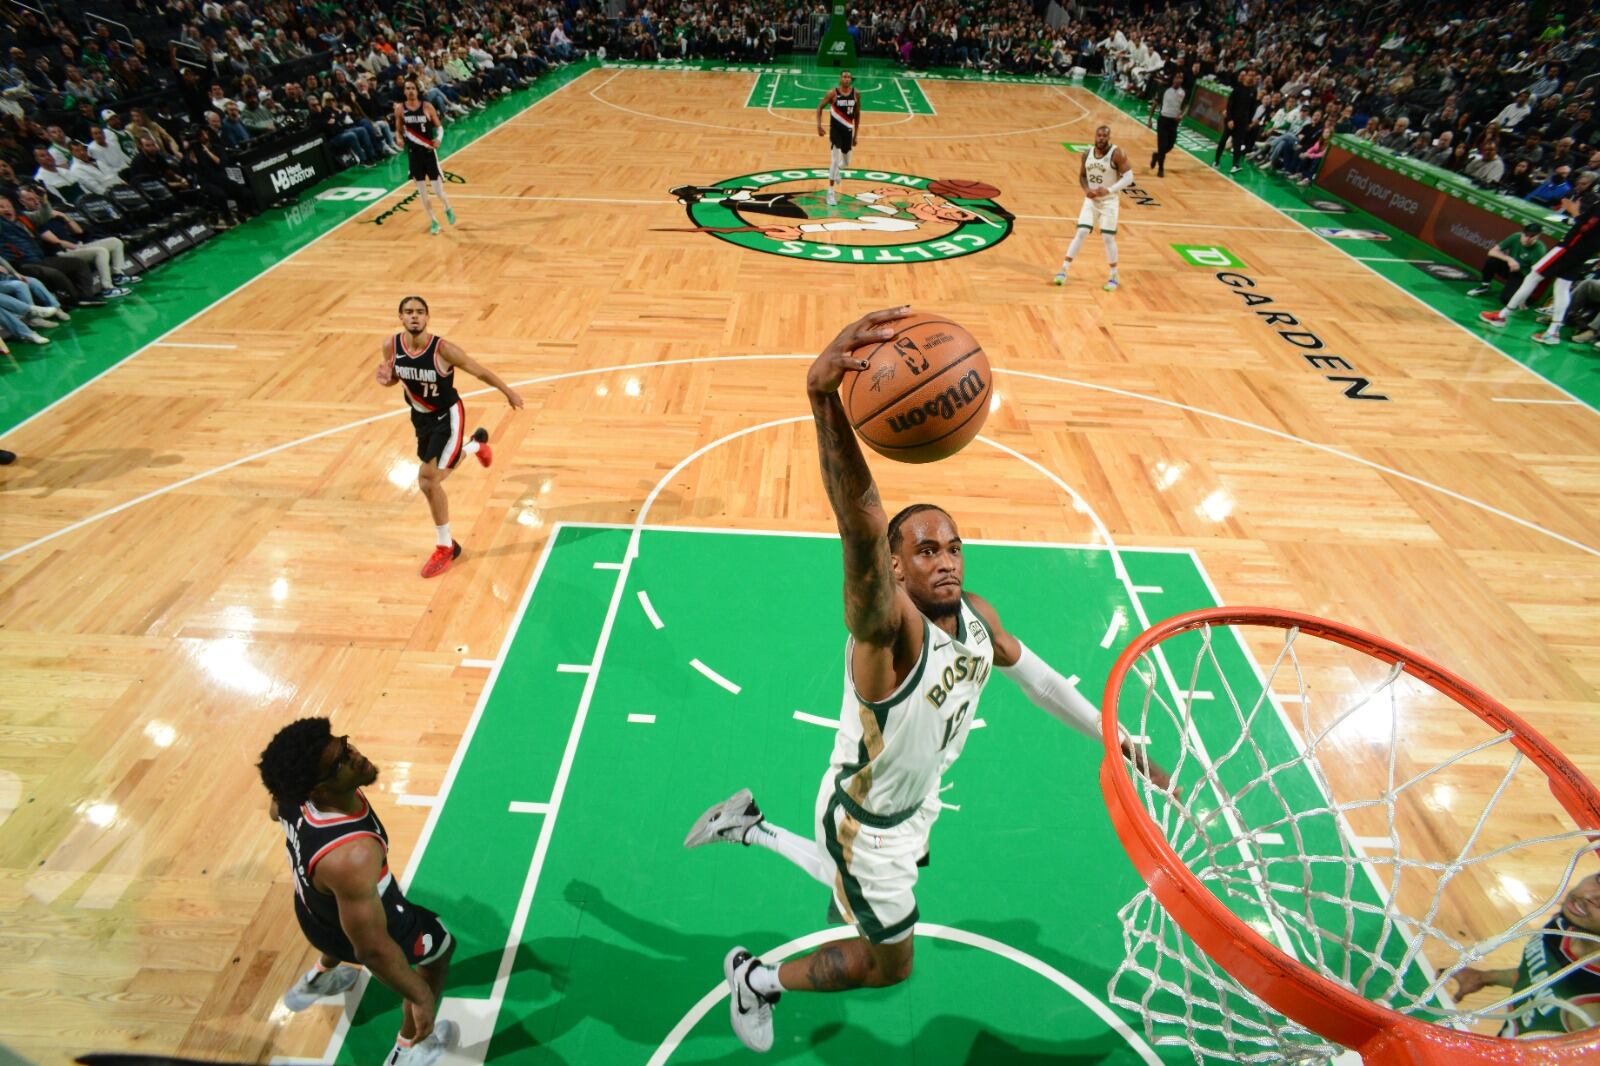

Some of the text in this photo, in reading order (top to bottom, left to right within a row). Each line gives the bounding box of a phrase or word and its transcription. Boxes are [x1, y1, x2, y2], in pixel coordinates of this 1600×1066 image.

[602, 63, 801, 74] BOSTON CELTICS
[836, 99, 855, 107] PORTLAND
[404, 115, 427, 124] PORTLAND
[420, 123, 426, 132] 5
[289, 166, 316, 186] BOSTON
[1086, 162, 1106, 173] BOSTON
[751, 168, 923, 187] BOSTON
[1089, 174, 1104, 184] 26
[1345, 169, 1368, 191] Find
[1366, 177, 1392, 201] your
[1389, 191, 1419, 215] pace
[777, 233, 988, 262] CELTICS
[1186, 247, 1232, 266] TD
[1216, 272, 1391, 401] GARDEN
[395, 365, 437, 383] PORTLAND
[421, 383, 440, 398] 72
[887, 368, 985, 433] Wilson
[936, 700, 970, 752] 12
